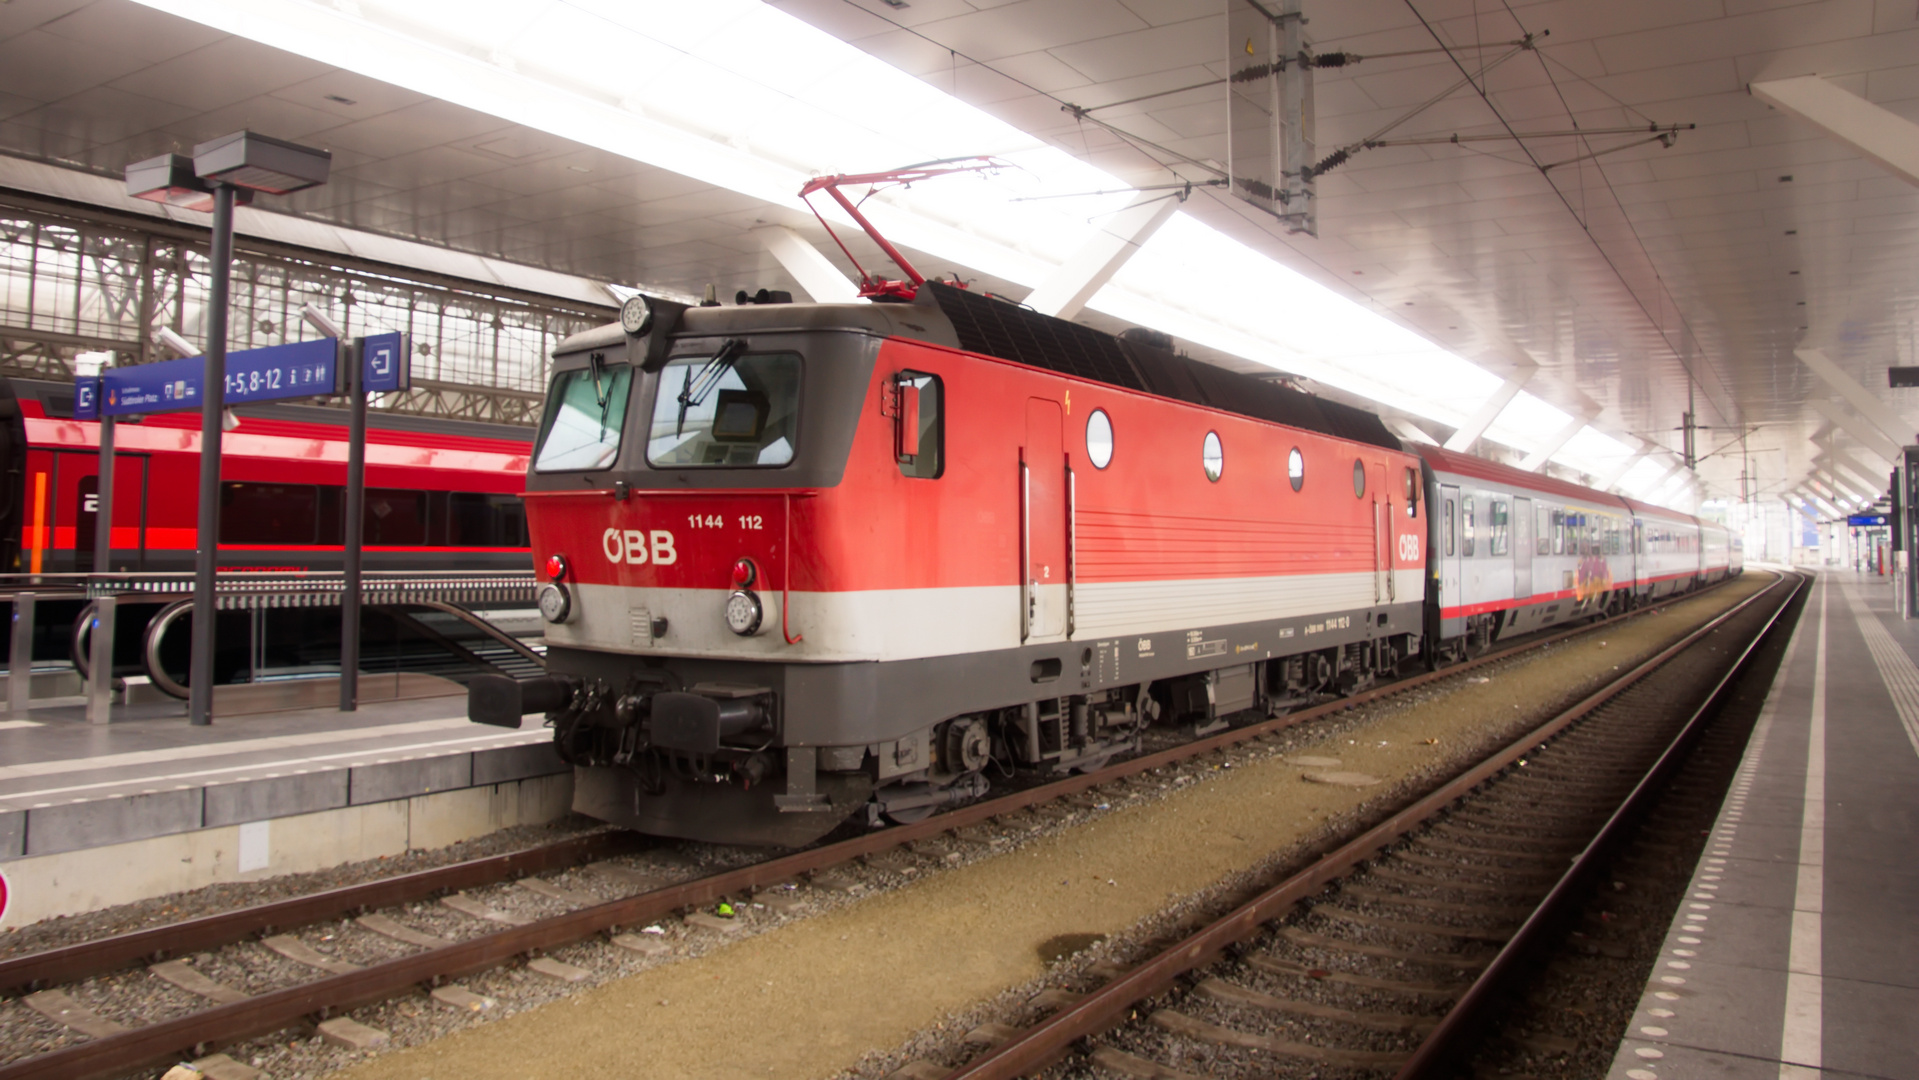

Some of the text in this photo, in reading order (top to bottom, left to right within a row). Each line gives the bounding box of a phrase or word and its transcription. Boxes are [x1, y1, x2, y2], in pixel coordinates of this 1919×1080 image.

[224, 367, 281, 395] 1-5,8-12
[688, 514, 763, 530] 1144 112
[602, 527, 677, 566] ÖBB
[1399, 533, 1419, 562] ÖBB
[1043, 565, 1050, 579] 2
